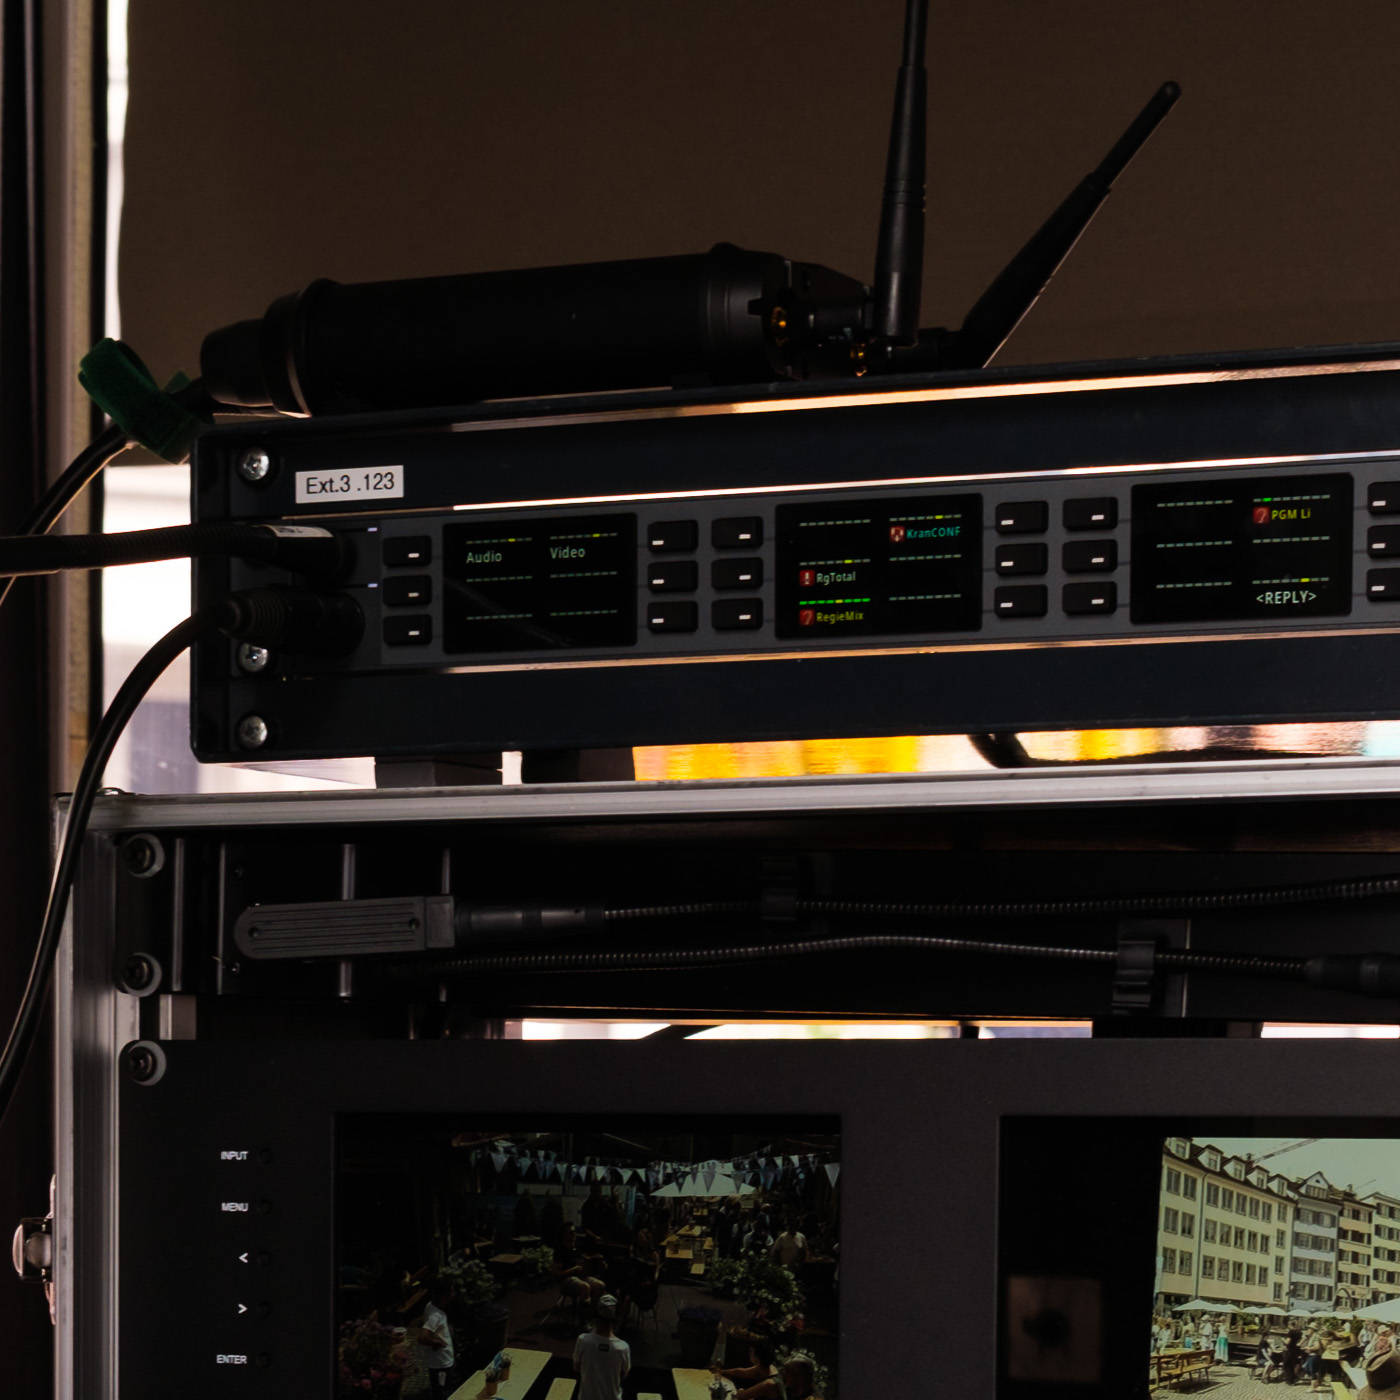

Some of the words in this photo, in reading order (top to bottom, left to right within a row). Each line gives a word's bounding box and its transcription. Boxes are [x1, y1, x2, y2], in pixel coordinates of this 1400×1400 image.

[306, 474, 351, 495] Ext.3
[1271, 508, 1297, 520] PGM
[906, 525, 961, 540] KranCONF
[466, 550, 503, 564] Audio
[549, 546, 586, 560] Video
[816, 571, 856, 586] RgTotal
[1256, 590, 1317, 605] <REPLY>
[816, 611, 864, 625] RegieMix
[220, 1150, 249, 1161] INPUT
[221, 1202, 249, 1213] MENU
[216, 1354, 248, 1365] ENTER
